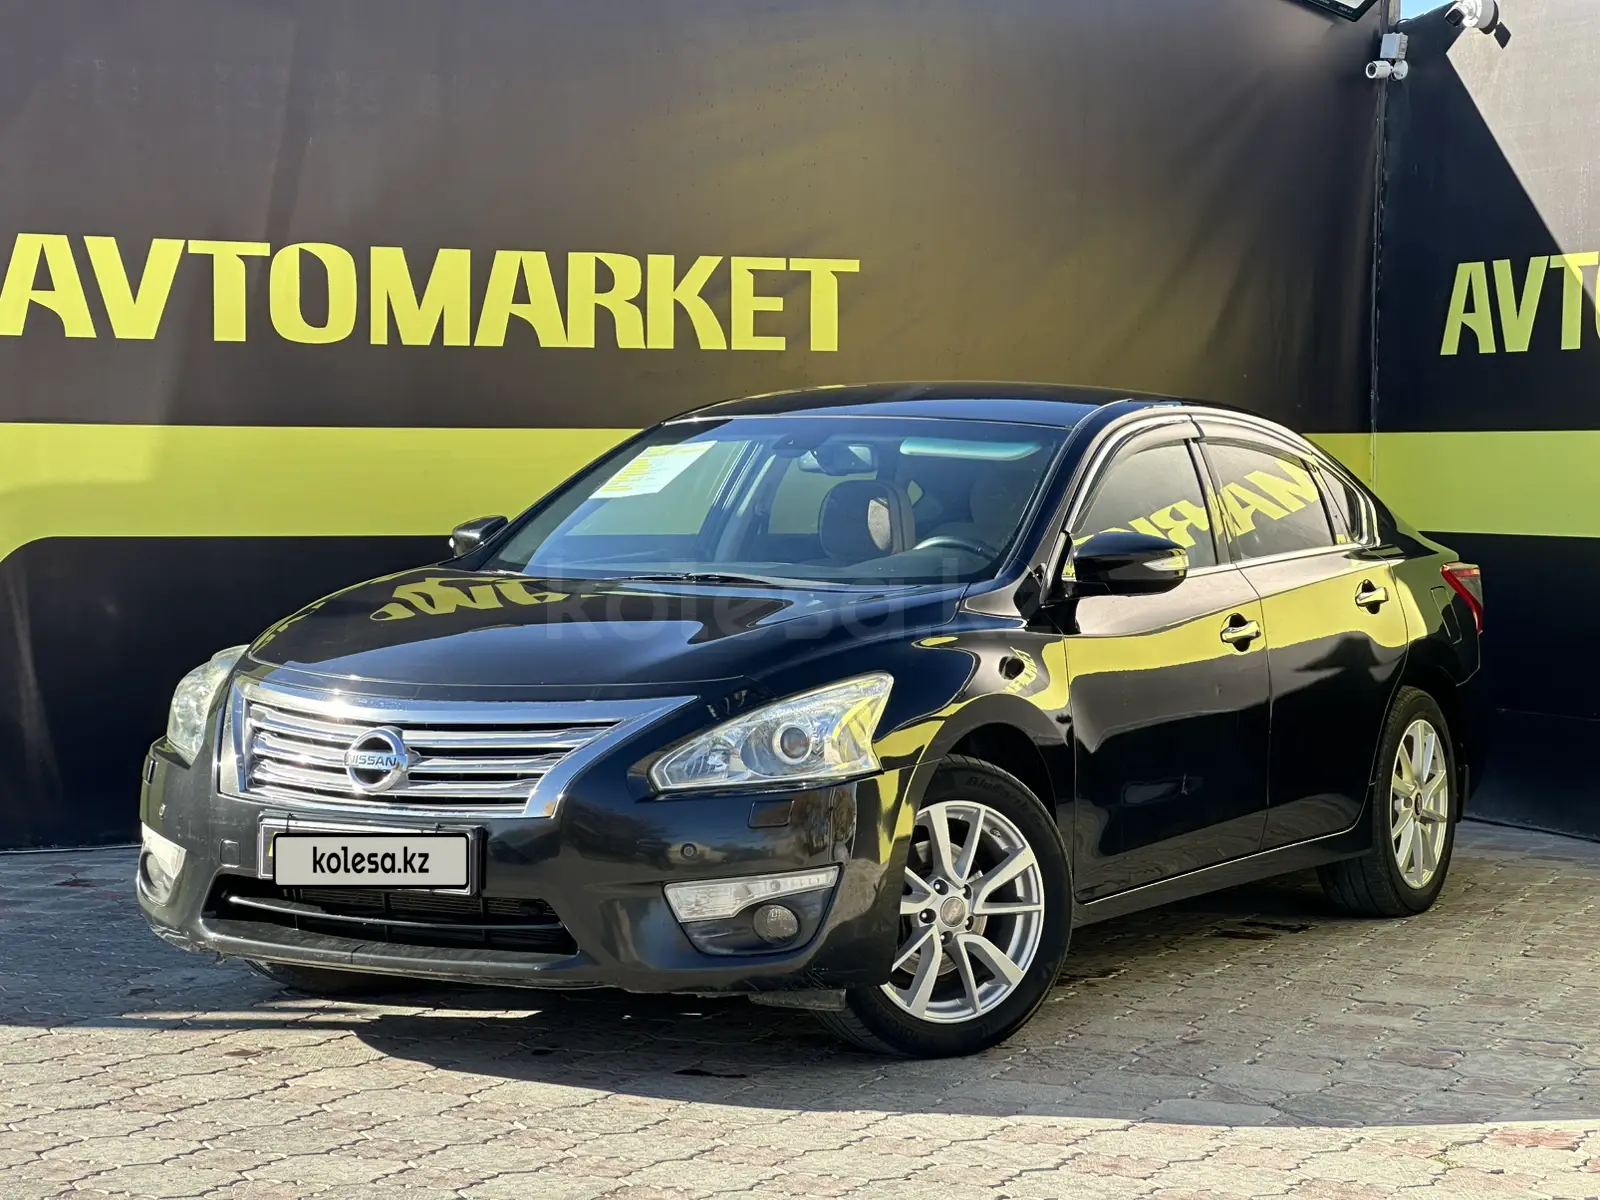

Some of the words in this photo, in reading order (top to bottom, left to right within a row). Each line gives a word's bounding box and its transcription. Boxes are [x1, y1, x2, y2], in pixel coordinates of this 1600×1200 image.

[0, 233, 861, 353] AVTOMARKET
[1440, 251, 1600, 355] AVT
[344, 753, 398, 768] NISSAN
